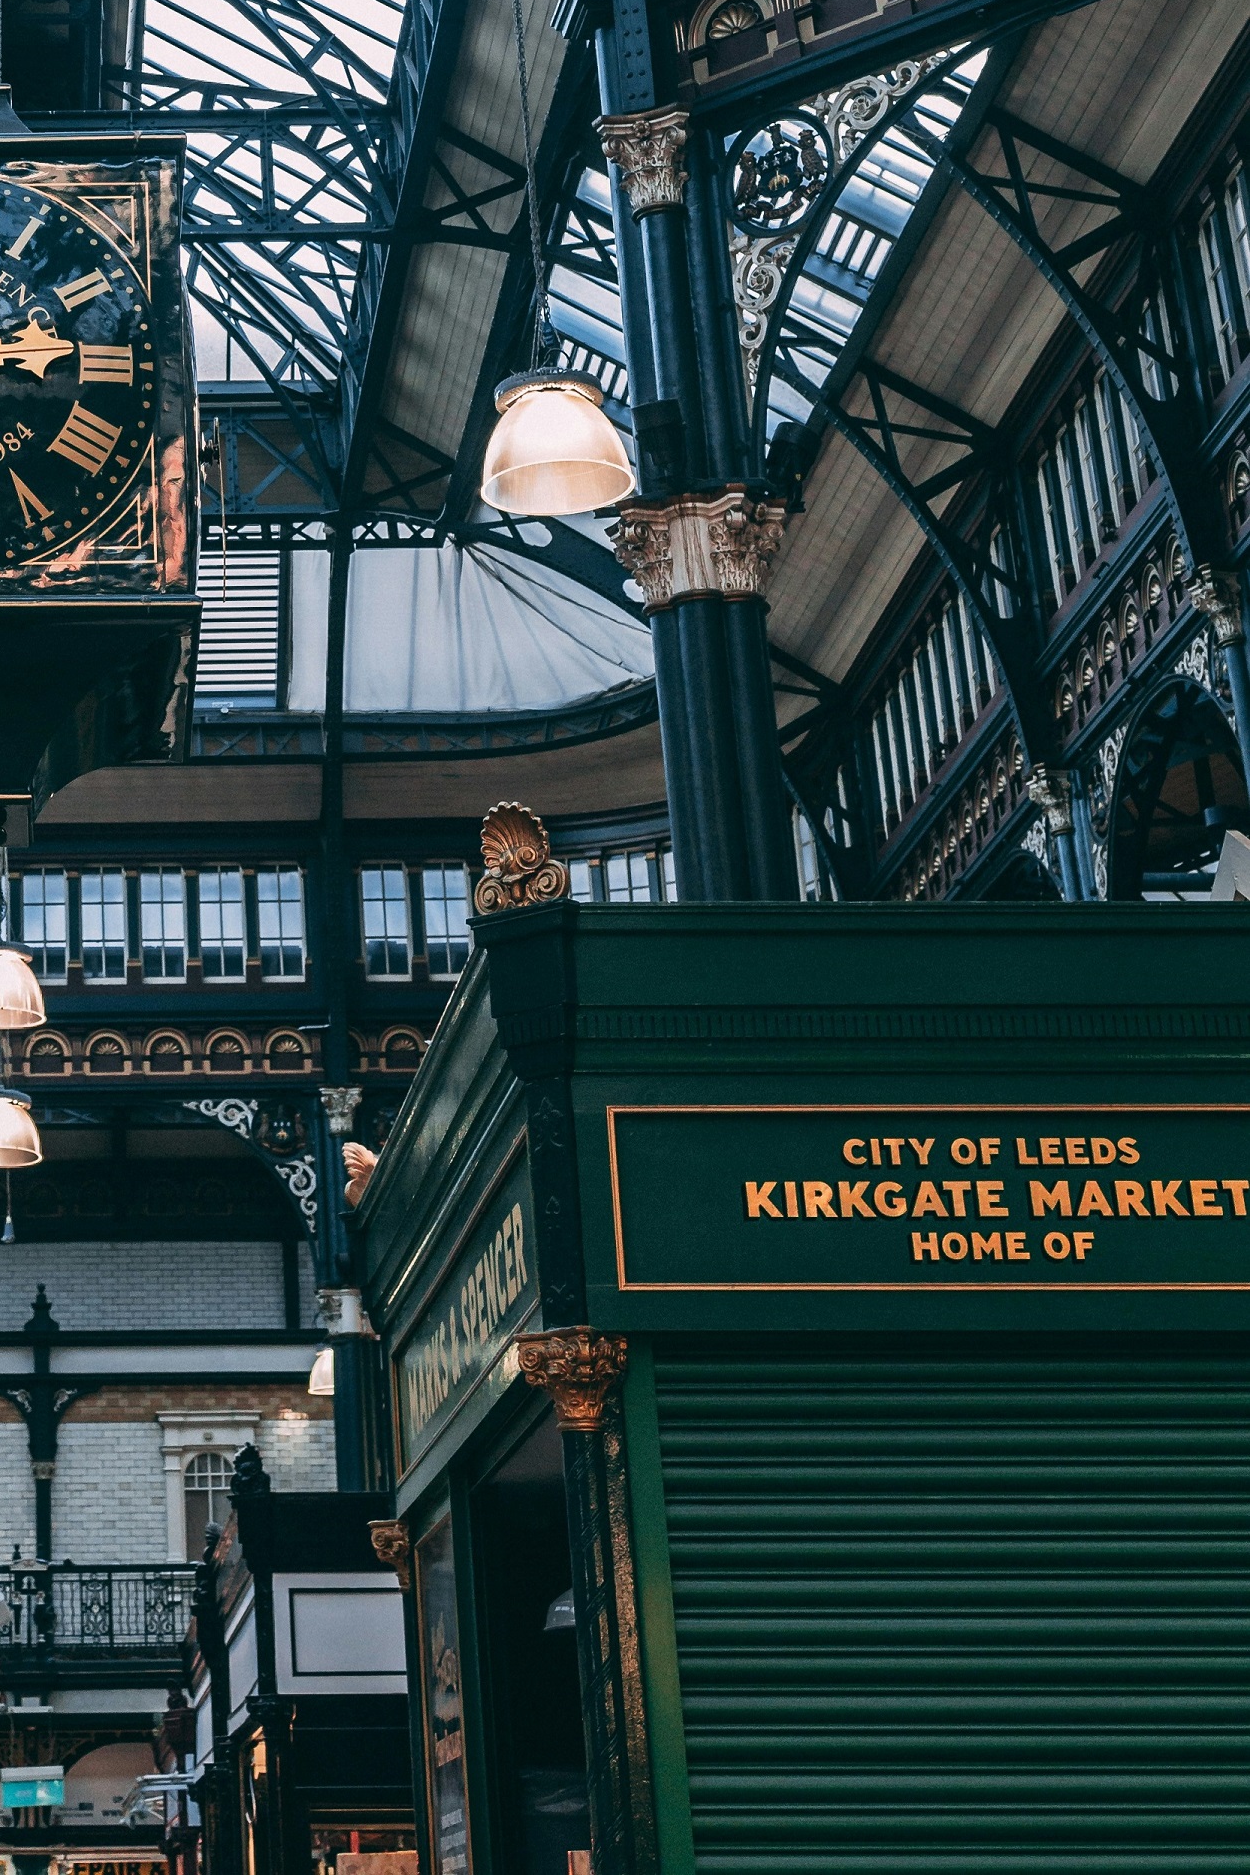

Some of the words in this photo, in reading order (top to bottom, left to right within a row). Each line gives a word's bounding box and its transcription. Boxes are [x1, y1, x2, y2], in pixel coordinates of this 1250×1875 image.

[4, 214, 46, 261] I
[53, 267, 113, 313] II
[78, 341, 133, 387] III
[46, 400, 123, 478] IIII
[9, 467, 54, 525] V
[841, 1136, 937, 1167] CITY
[950, 1136, 1002, 1167] OF
[1016, 1136, 1142, 1167] LEEDS
[744, 1179, 1010, 1220] KIRKGATE
[1029, 1178, 1250, 1219] MARKET
[910, 1230, 1032, 1263] HOME
[1043, 1230, 1096, 1263] OF
[408, 1321, 448, 1441] MARKS
[450, 1306, 462, 1385] &
[461, 1202, 528, 1366] SPENCER
[59, 1862, 141, 1875] EPAIR
